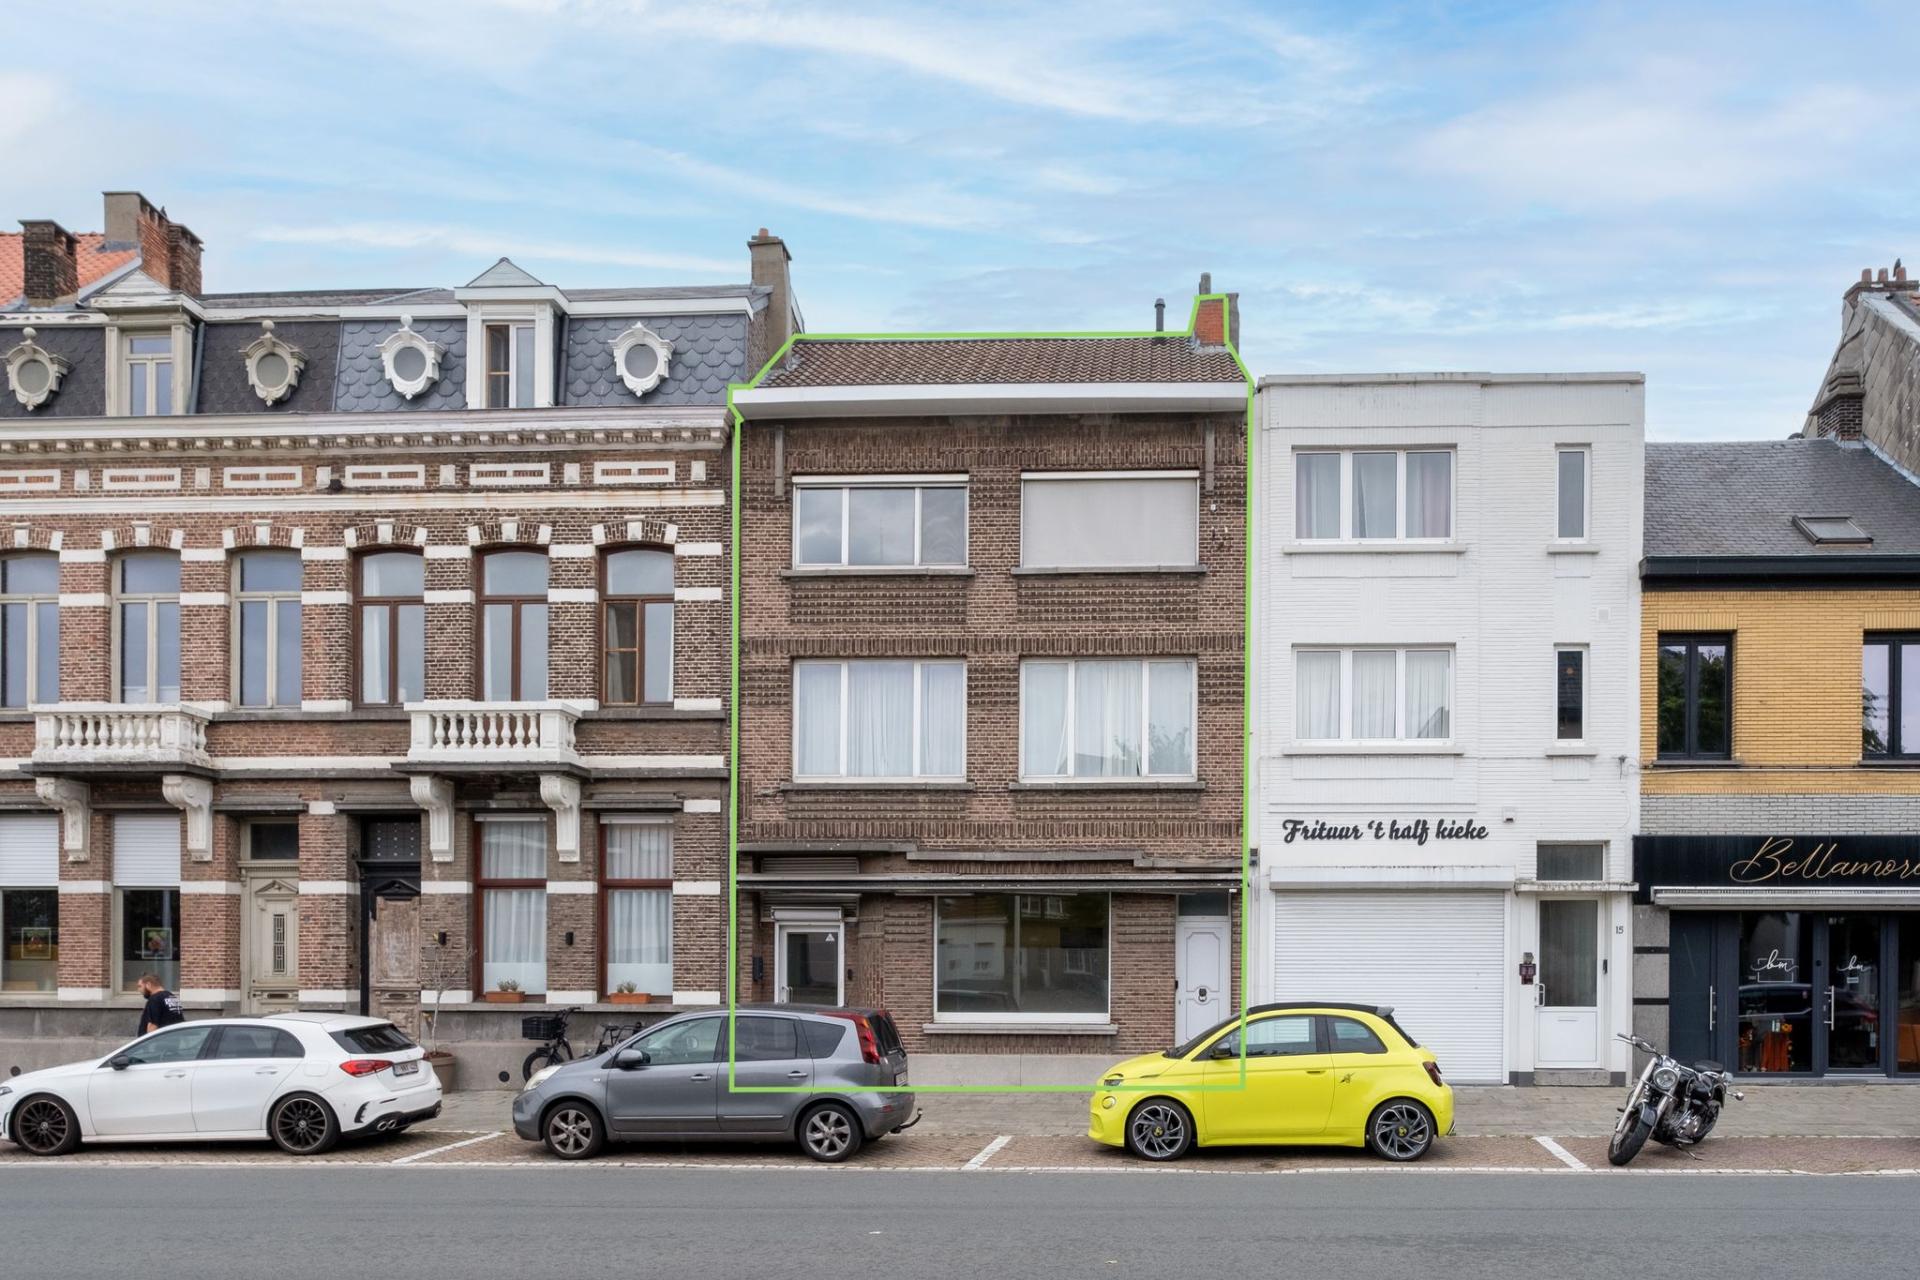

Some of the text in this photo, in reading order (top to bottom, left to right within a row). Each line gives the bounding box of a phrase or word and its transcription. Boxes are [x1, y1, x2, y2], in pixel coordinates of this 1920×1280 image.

[1282, 819, 1364, 844] Frituur
[1388, 819, 1430, 846] half
[1435, 818, 1489, 840] kieke
[1615, 925, 1625, 935] 15
